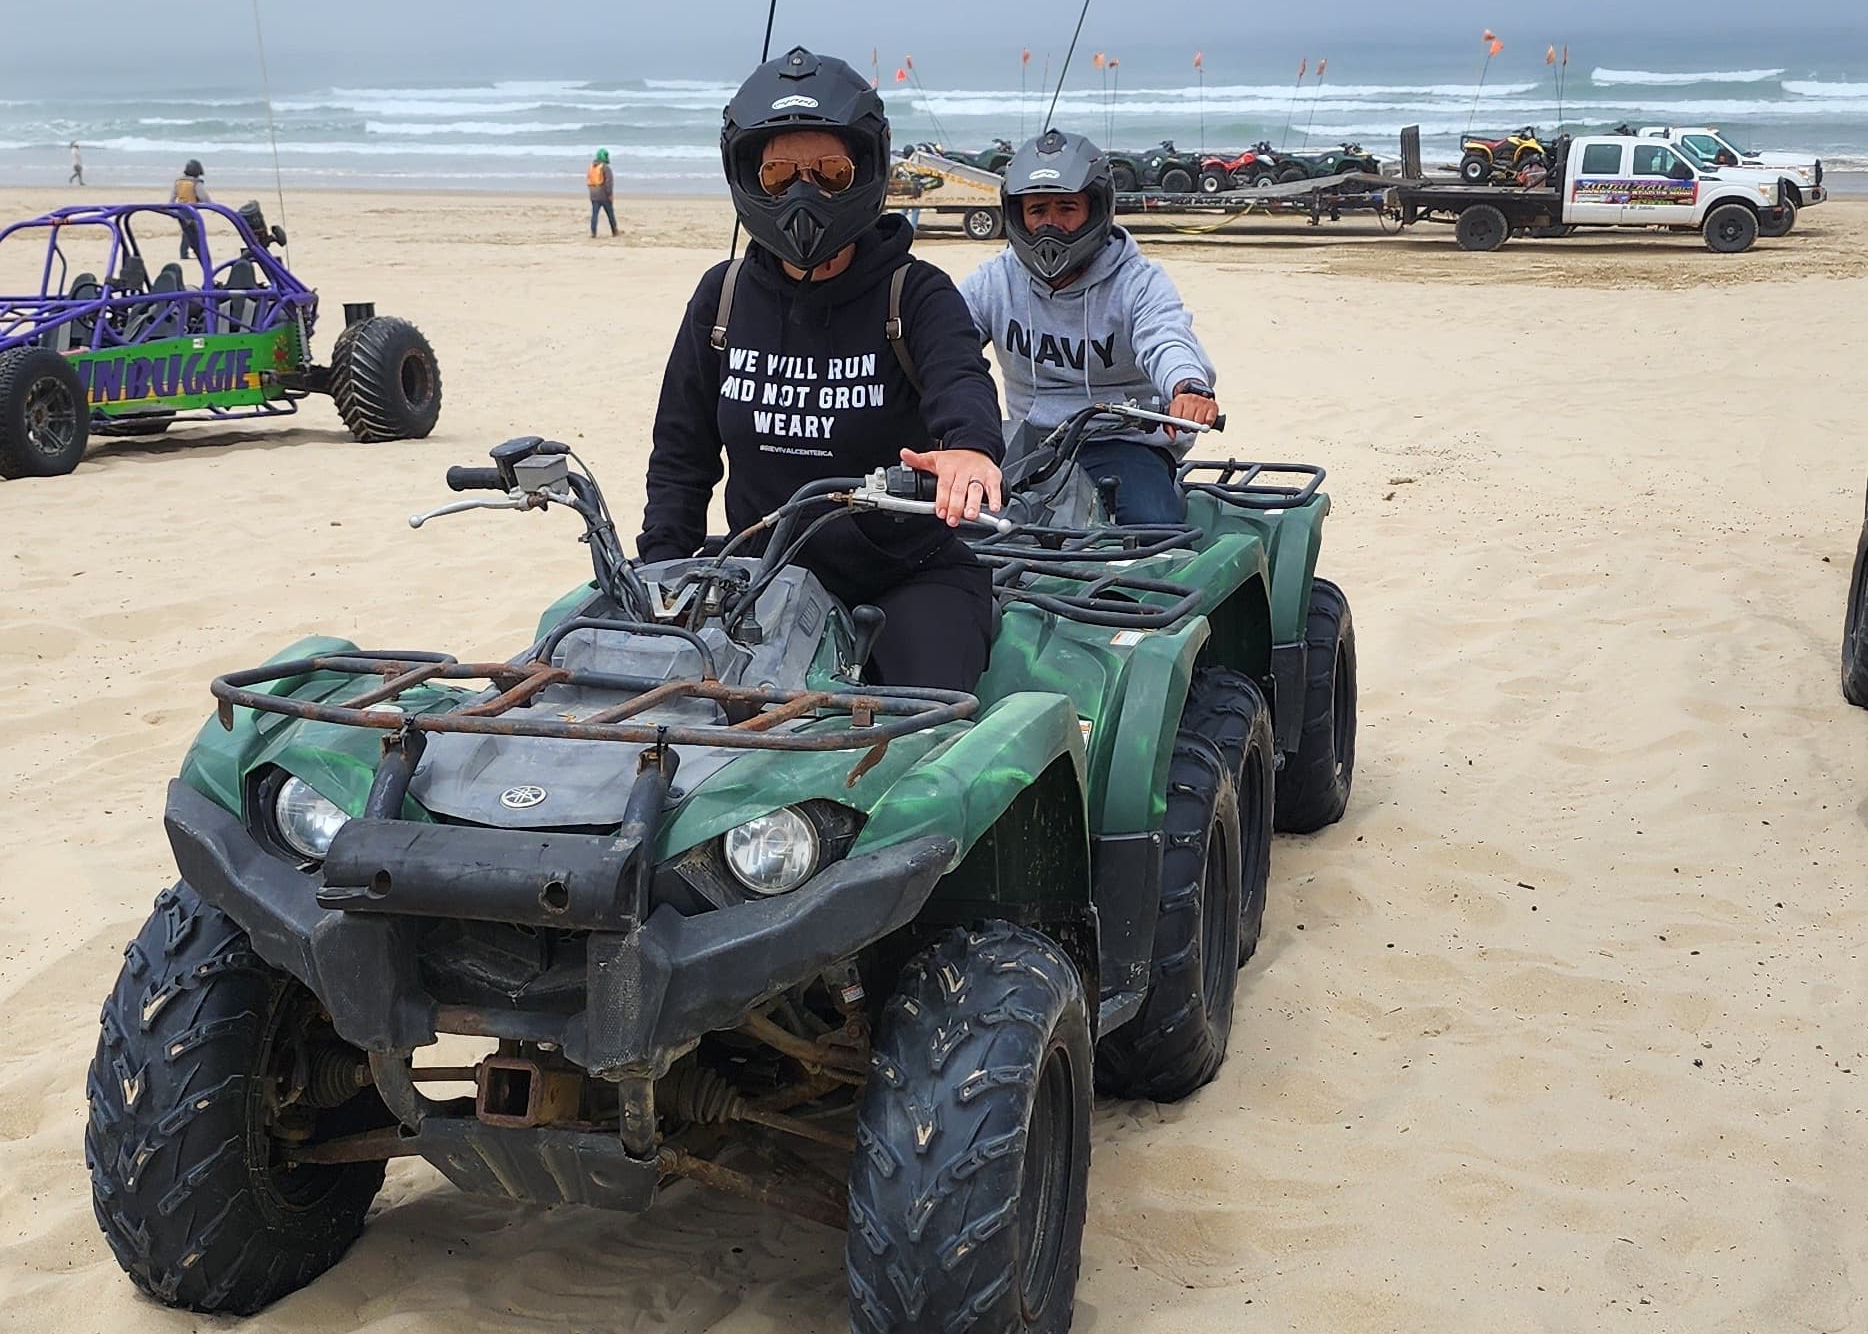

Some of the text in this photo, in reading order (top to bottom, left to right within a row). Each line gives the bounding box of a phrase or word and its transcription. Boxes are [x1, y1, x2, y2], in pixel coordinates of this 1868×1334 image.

[1006, 318, 1115, 371] NAVY
[729, 347, 876, 380] WE WILL RUN
[720, 375, 885, 409] AND NOT GROW
[753, 410, 835, 439] WEARY
